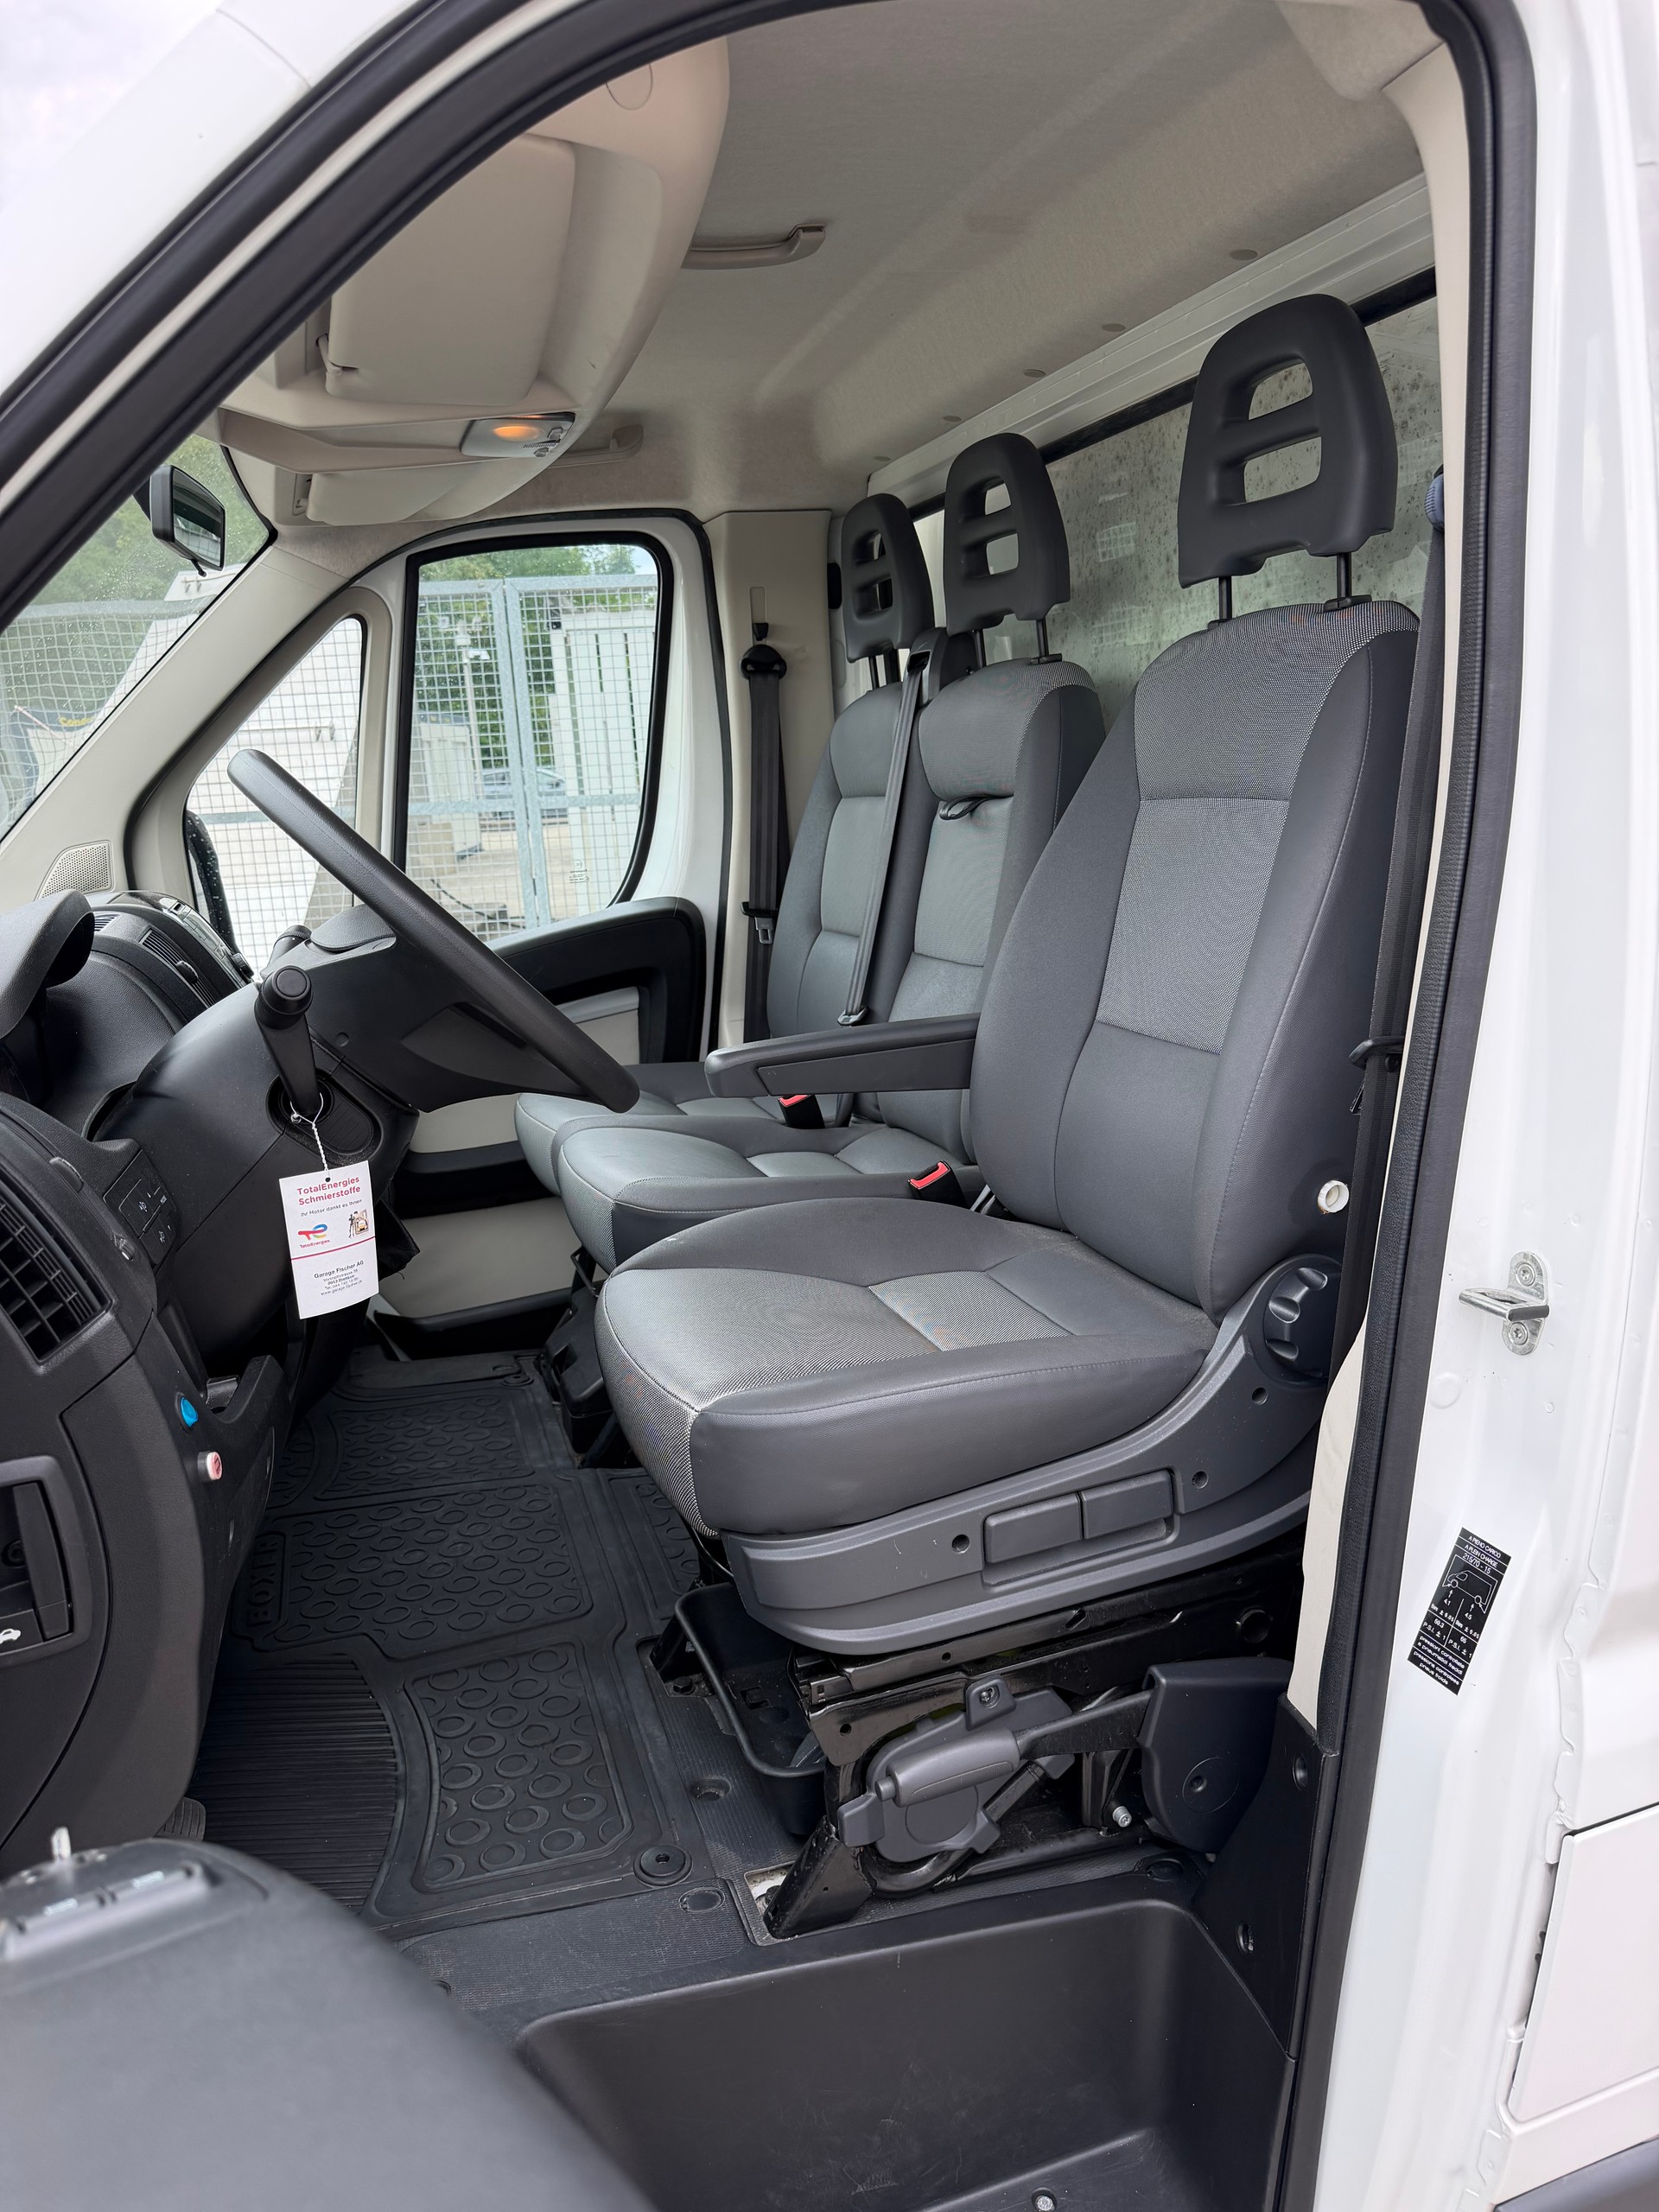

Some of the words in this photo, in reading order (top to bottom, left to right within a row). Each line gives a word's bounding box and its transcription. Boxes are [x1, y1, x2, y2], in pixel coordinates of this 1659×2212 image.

[296, 1176, 359, 1195] TotalEnergies
[298, 1186, 360, 1205] Schmierstoffe
[326, 1204, 341, 1212] dankt
[314, 1270, 335, 1279] Garage
[336, 1264, 355, 1274] Fischer
[1468, 1546, 1480, 1557] PLEIN
[1479, 1553, 1498, 1568] CHARGE
[1471, 1537, 1485, 1548] PIENO
[1484, 1545, 1501, 1559] CARICO
[1462, 1553, 1480, 1567] 215/70
[1484, 1566, 1491, 1574] 15
[1464, 1611, 1472, 1620] 4.5
[1420, 1662, 1434, 1675] pneus
